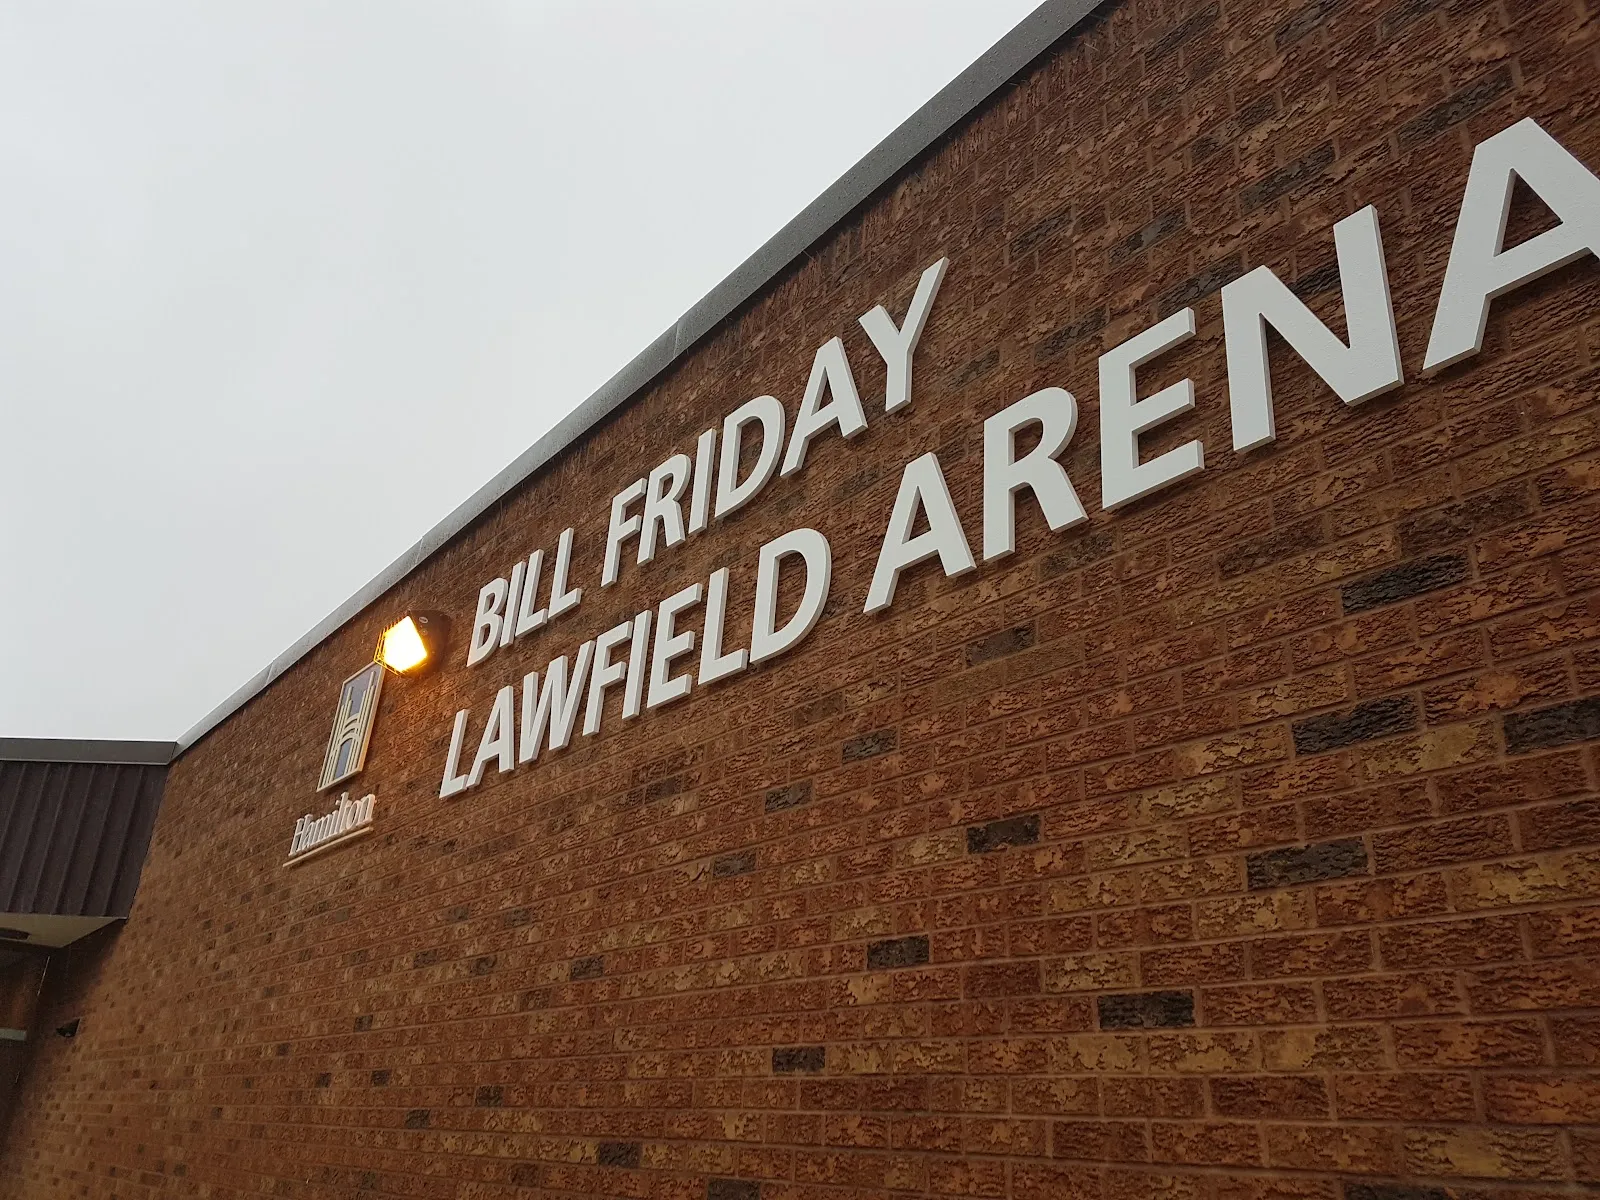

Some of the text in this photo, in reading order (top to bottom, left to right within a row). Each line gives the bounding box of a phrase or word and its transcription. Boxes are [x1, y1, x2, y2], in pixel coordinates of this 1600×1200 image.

[439, 117, 1600, 798] LAWFIELD ARENA
[466, 257, 950, 667] BILL FRIDAY
[288, 792, 376, 857] Hamilton
